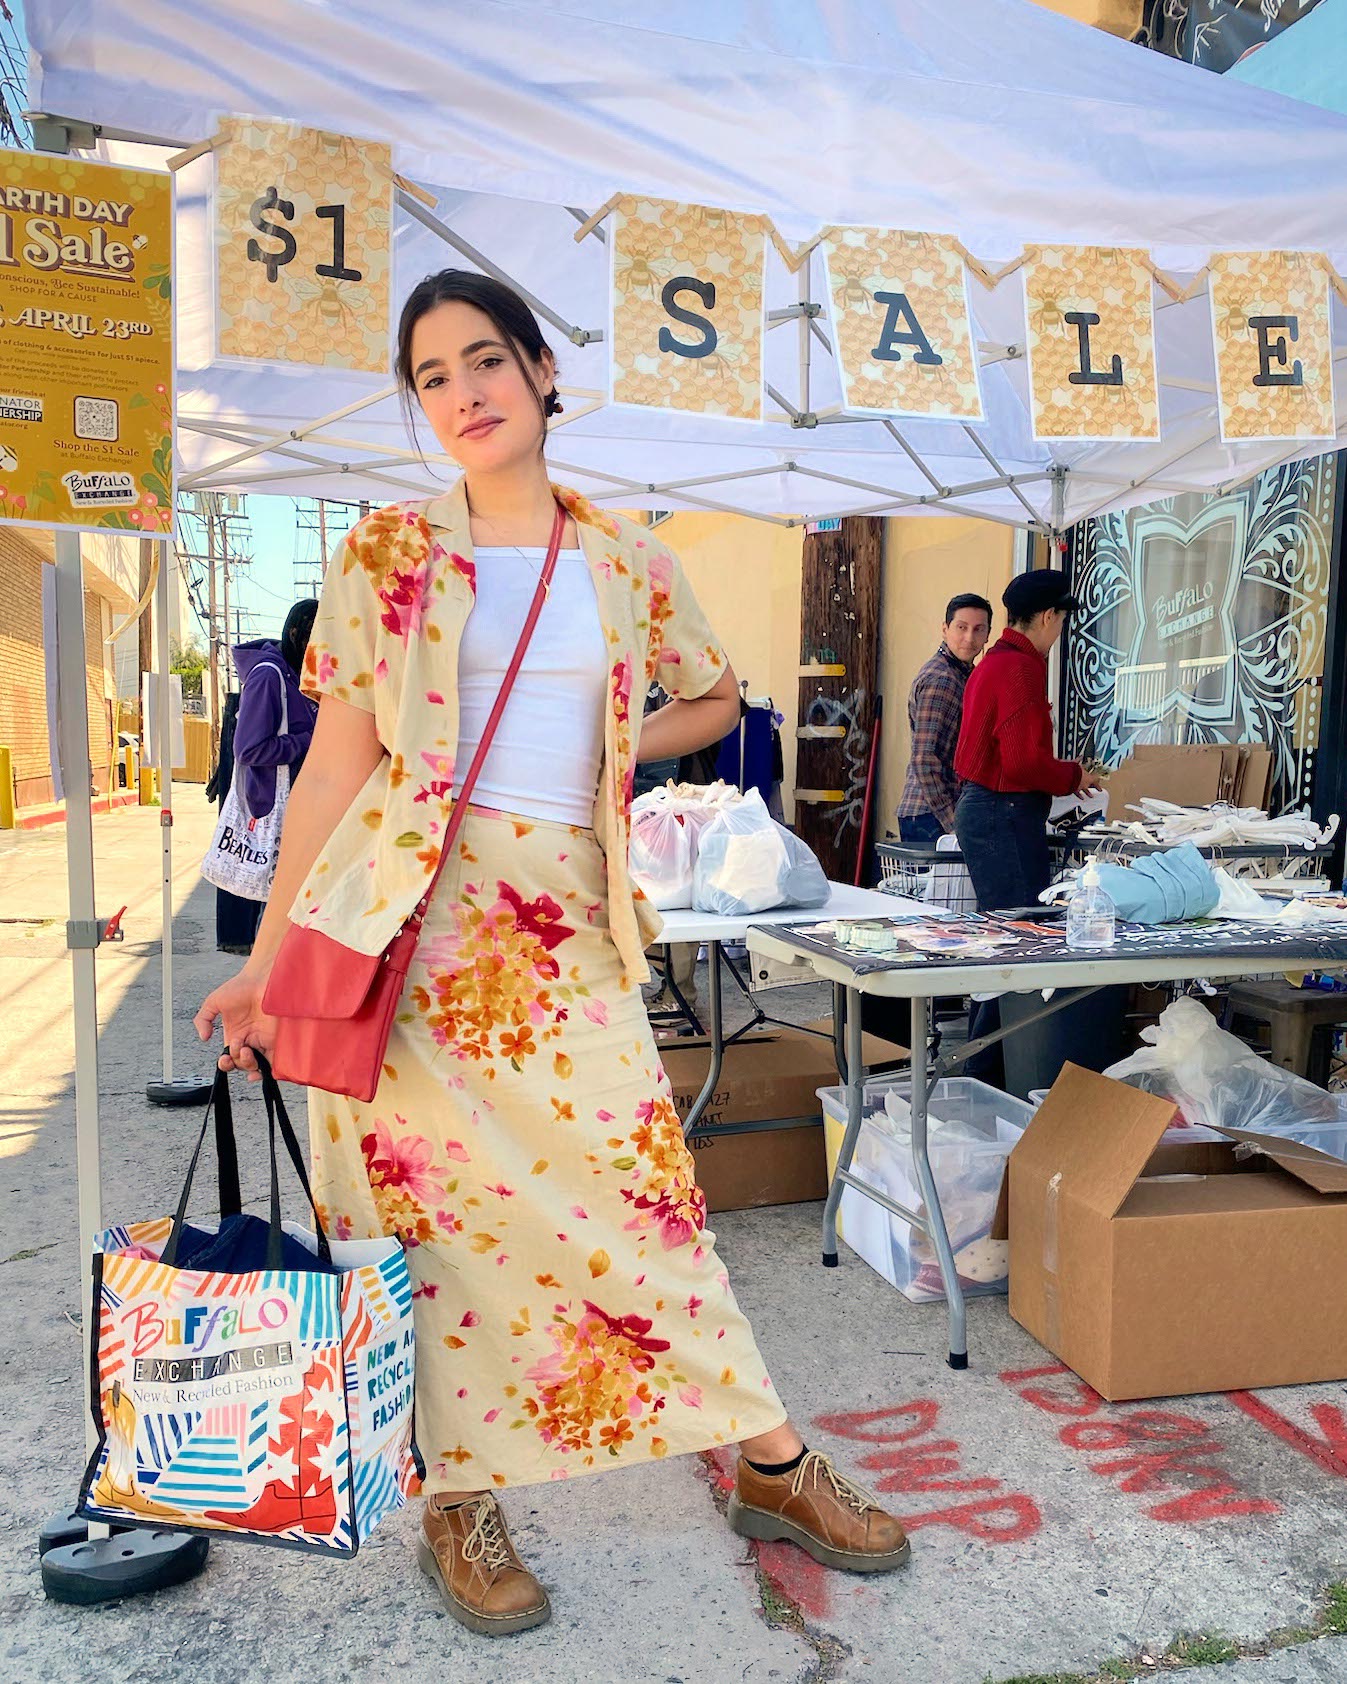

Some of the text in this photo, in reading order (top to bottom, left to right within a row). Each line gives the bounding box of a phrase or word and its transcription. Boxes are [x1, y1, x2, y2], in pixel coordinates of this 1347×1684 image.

[0, 186, 134, 227] RTH DAY
[22, 217, 134, 272] Sale
[247, 186, 362, 282] $1
[0, 274, 140, 299] onscious, Bee Sustainable!
[9, 284, 36, 294] SHOP
[38, 288, 56, 297] FOR
[67, 292, 98, 303] CAUSE
[9, 307, 98, 339] APRIL
[102, 317, 153, 339] 23RD
[13, 340, 45, 351] clothing
[54, 345, 96, 356] accessories
[97, 350, 109, 358] for
[110, 352, 125, 360] just
[135, 356, 161, 365] apiece.
[0, 397, 41, 410] NATOR
[12, 387, 38, 397] friends
[0, 421, 28, 430] ator.org
[53, 439, 140, 458] Shop the $1 Sale
[70, 452, 96, 461] Buffalo
[75, 489, 132, 499] EXCHANGE
[218, 825, 268, 865] BEATLES
[134, 1343, 293, 1382] EXCHANGE
[367, 1338, 397, 1372] NEW
[133, 1388, 161, 1403] New
[235, 1374, 293, 1394] Fashion
